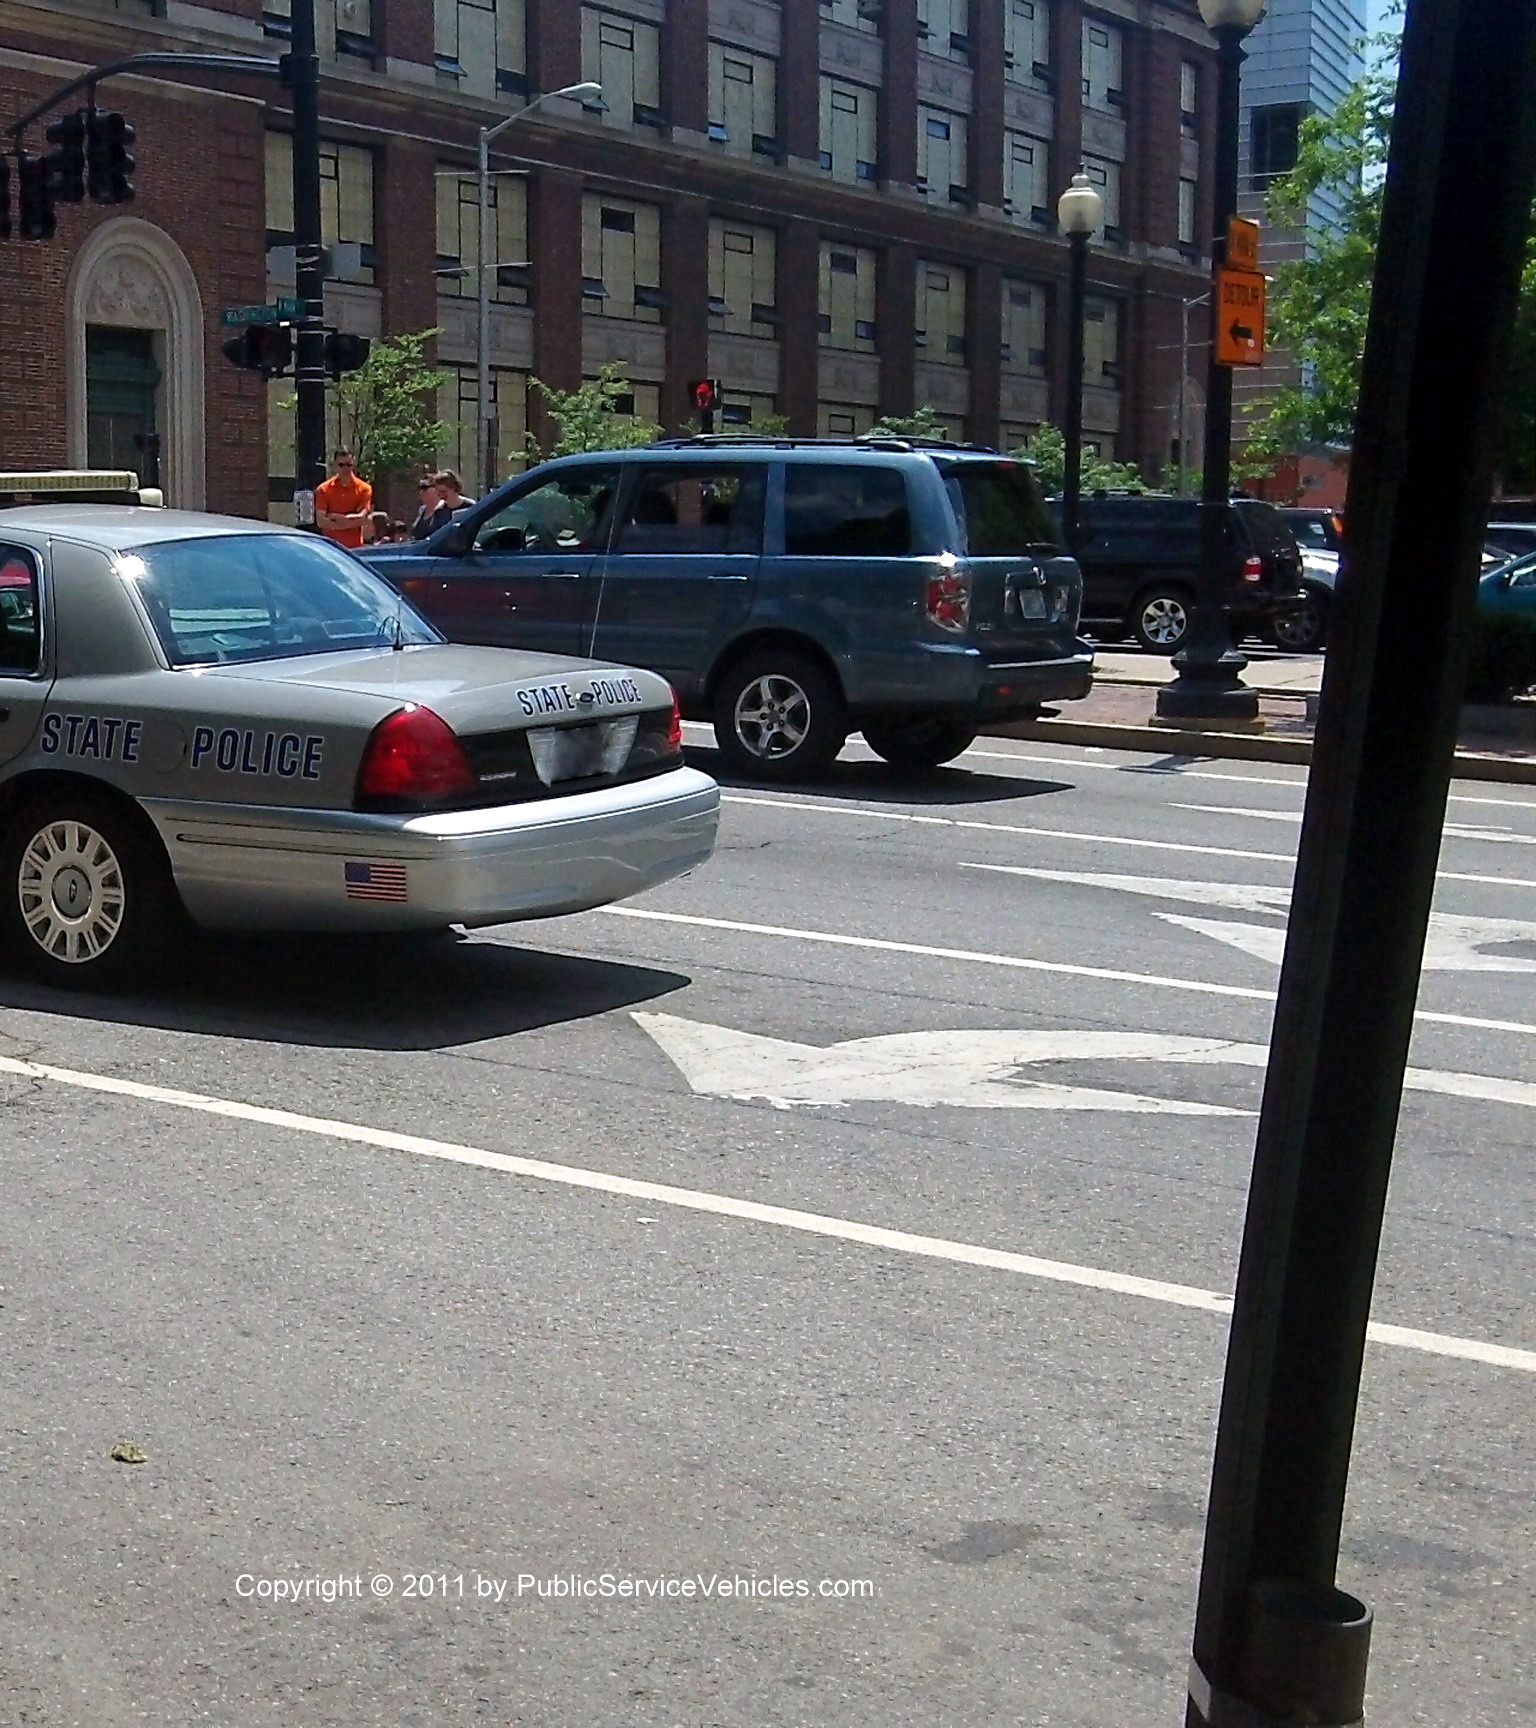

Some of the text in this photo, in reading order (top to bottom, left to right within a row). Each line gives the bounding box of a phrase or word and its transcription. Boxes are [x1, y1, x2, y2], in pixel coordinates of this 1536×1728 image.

[1223, 282, 1260, 306] DETOUR
[516, 677, 642, 717] STATE POLICE
[40, 713, 324, 781] STATE POLICE
